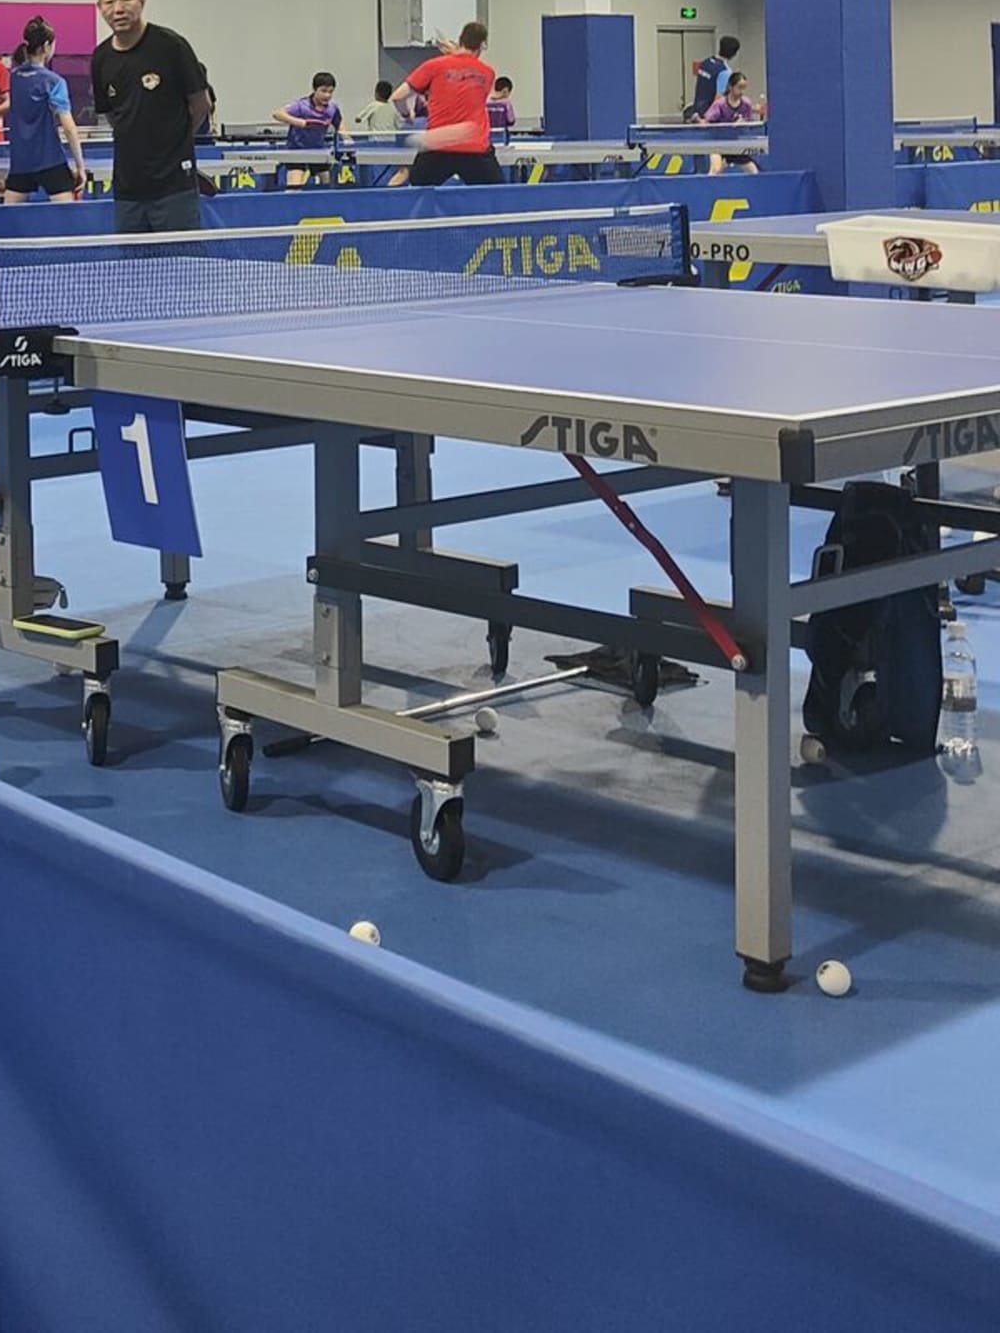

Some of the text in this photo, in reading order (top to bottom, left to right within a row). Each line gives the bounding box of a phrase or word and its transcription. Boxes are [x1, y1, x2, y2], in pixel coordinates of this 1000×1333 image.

[463, 233, 600, 278] STIGA
[0, 352, 43, 368] STIGA
[120, 413, 159, 506] 1
[520, 414, 658, 463] STIGA
